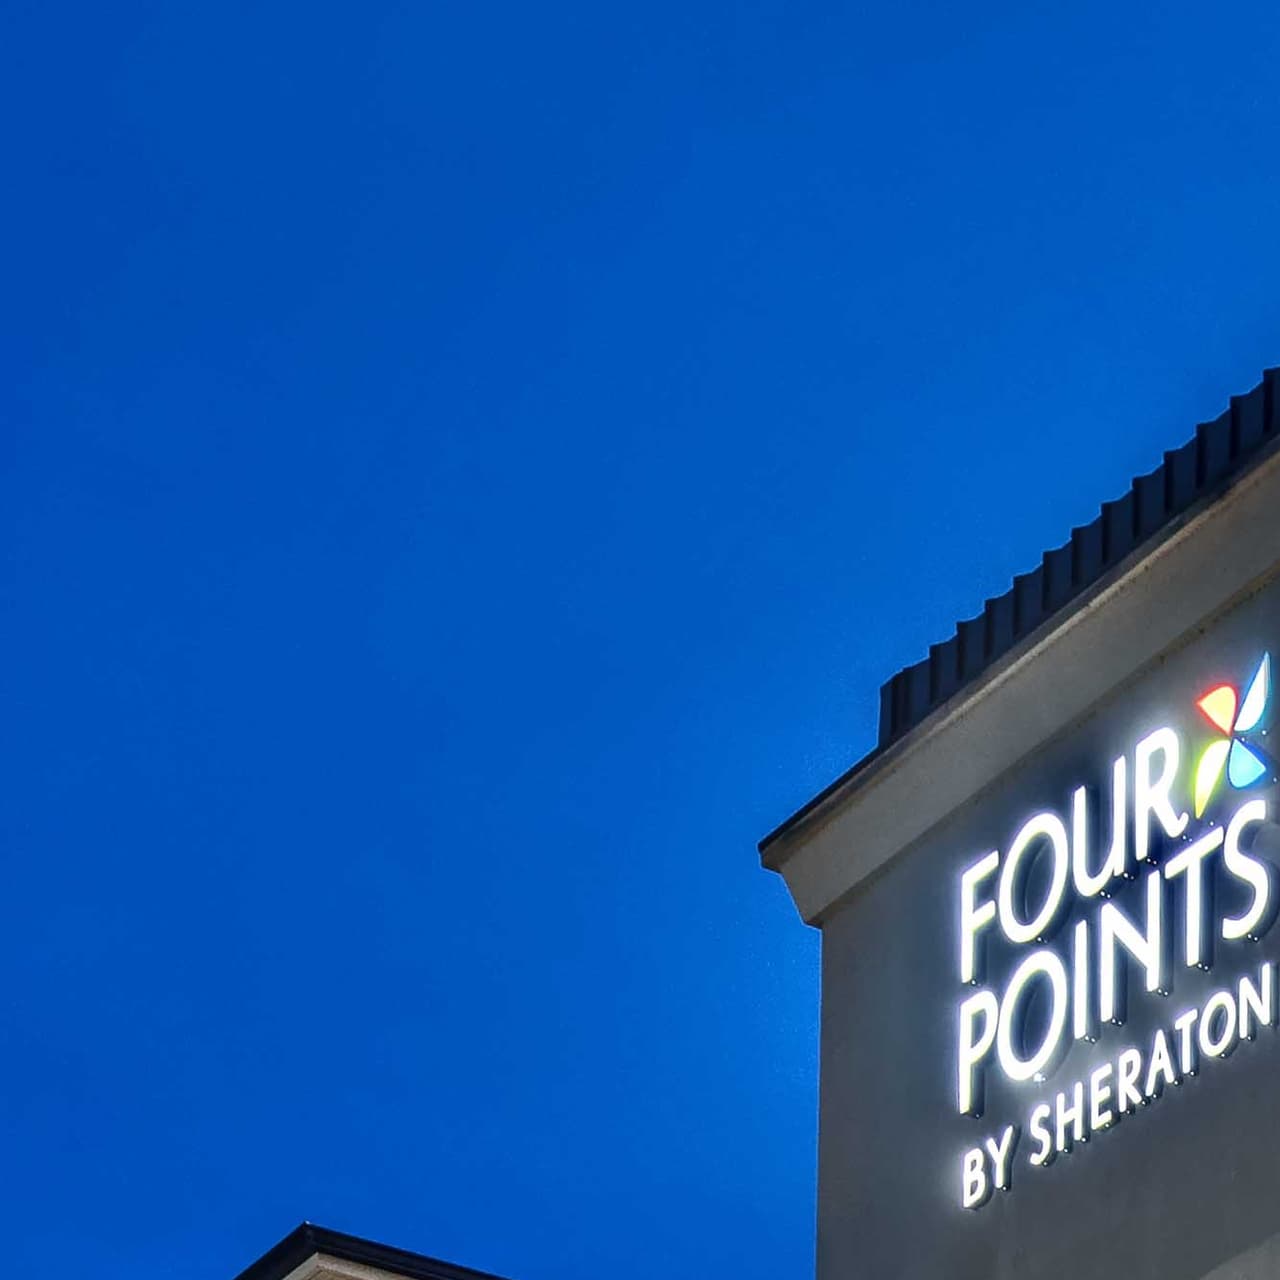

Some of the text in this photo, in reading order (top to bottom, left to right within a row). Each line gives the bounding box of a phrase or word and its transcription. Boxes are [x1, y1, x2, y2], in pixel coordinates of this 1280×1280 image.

[957, 799, 1272, 1116] POINTS
[959, 725, 1188, 984] FOUR
[962, 961, 1273, 1210] BY SHERATON
